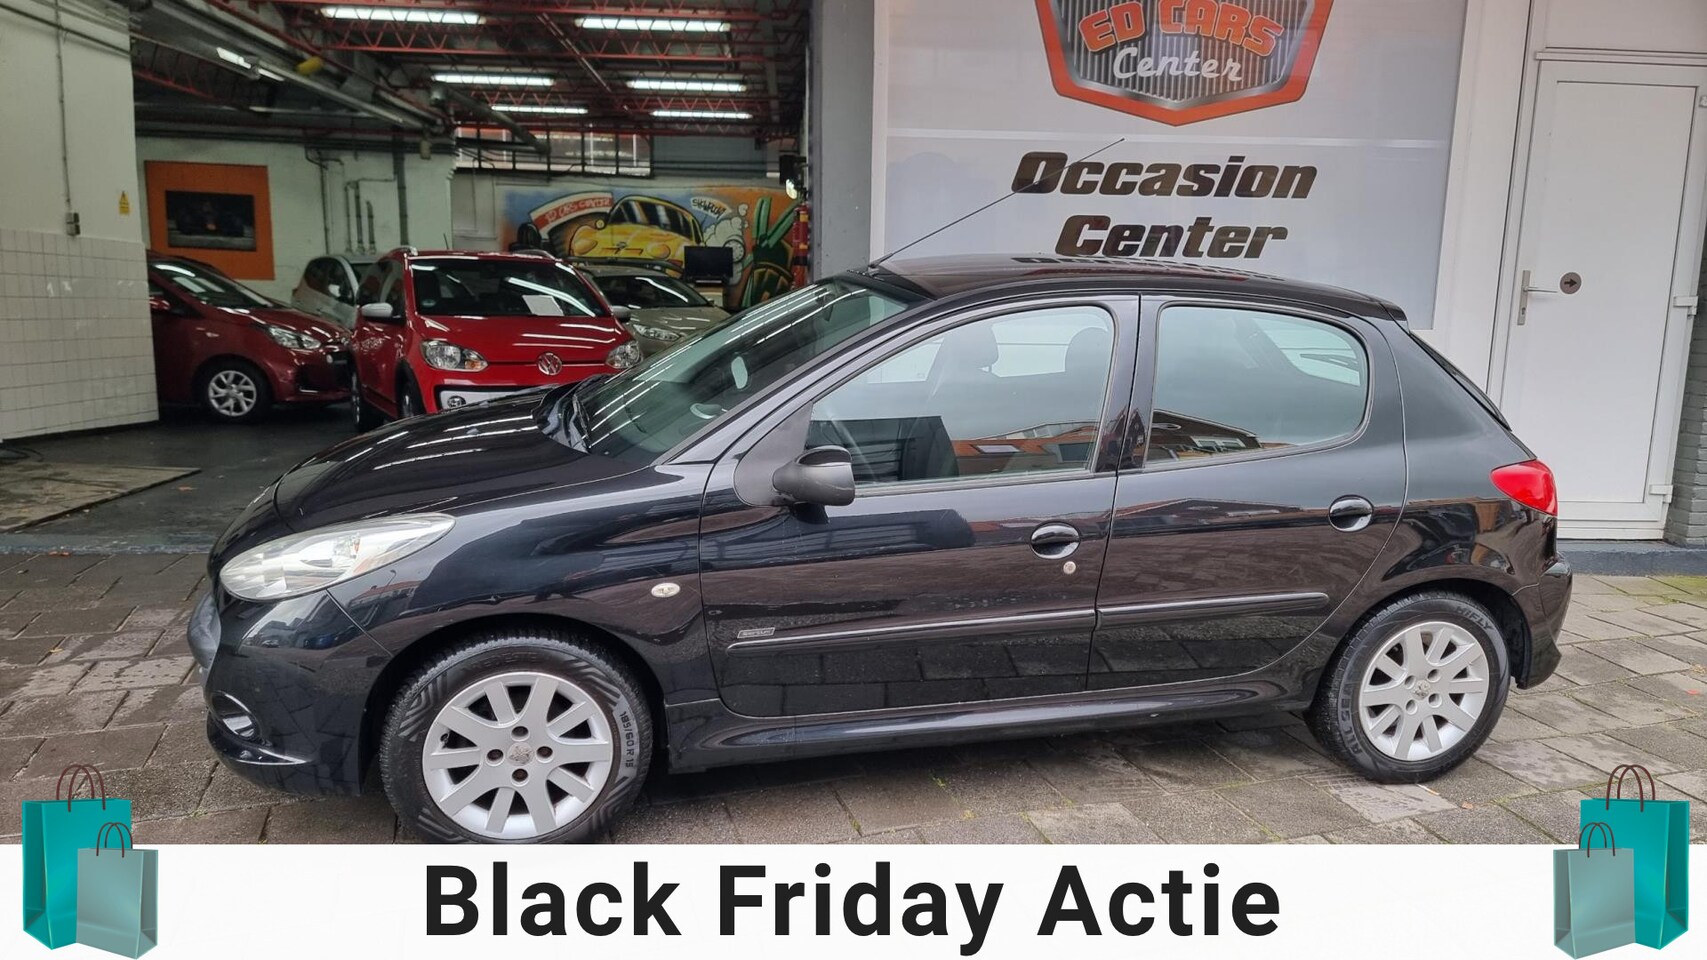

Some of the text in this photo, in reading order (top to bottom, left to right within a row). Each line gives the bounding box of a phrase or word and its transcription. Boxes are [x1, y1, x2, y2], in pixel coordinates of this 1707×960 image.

[1079, 0, 1284, 57] ED CARS
[1113, 47, 1242, 81] Center
[1011, 152, 1317, 198] Occasion
[1055, 215, 1288, 258] Center
[620, 711, 634, 747] 185/60
[626, 759, 634, 768] 15
